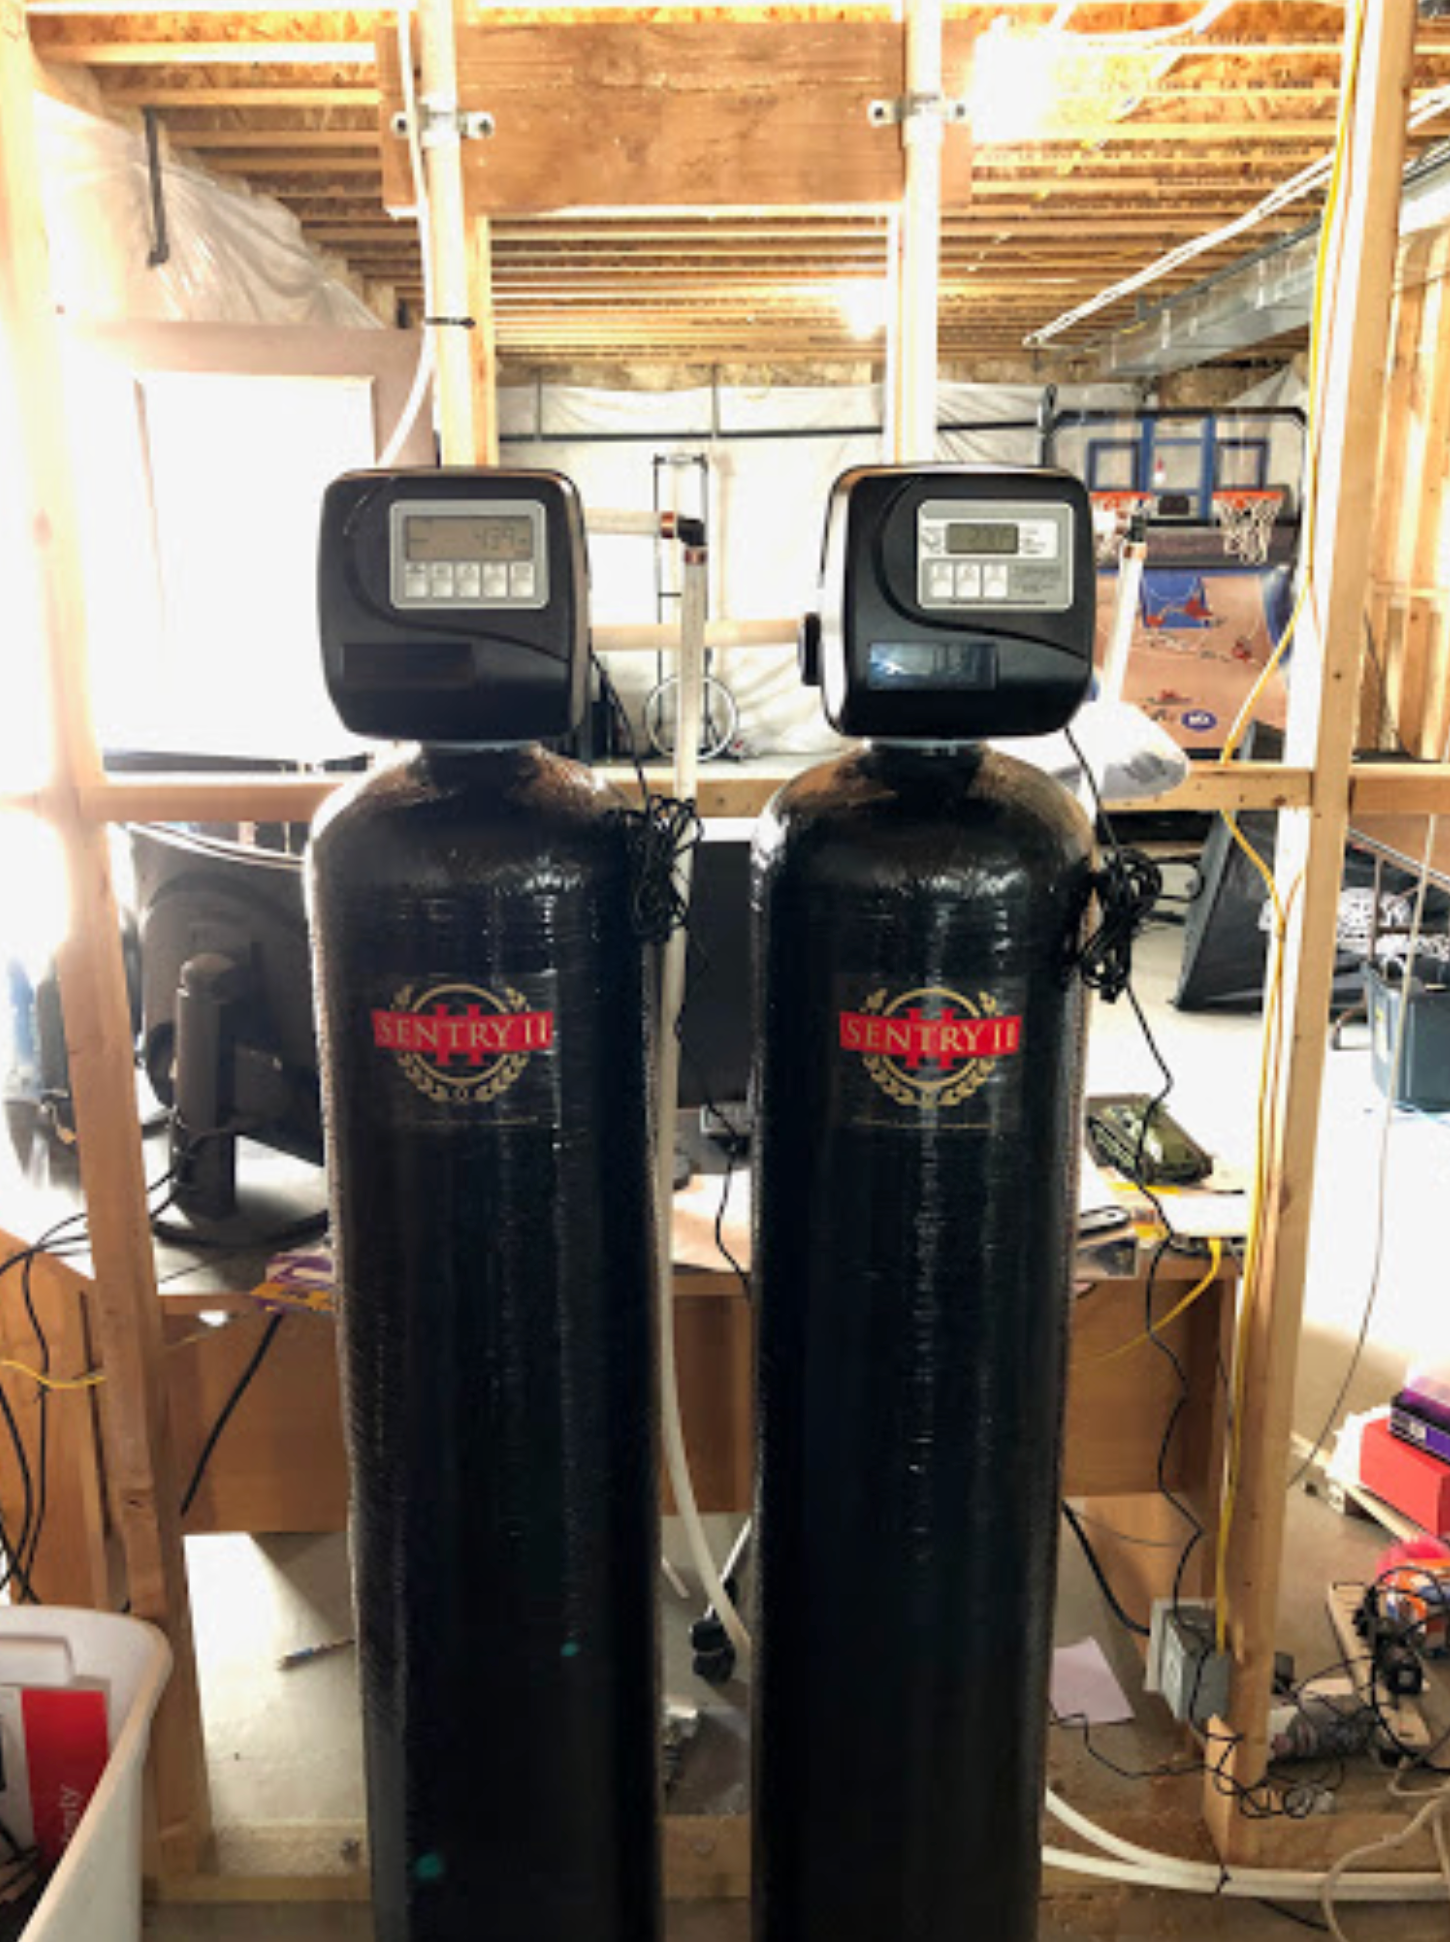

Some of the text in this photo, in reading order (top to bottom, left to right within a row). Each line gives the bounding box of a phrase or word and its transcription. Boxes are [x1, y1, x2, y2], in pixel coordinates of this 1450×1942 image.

[378, 1014, 548, 1048] SENTRY II
[847, 1018, 1017, 1052] SENTRY II
